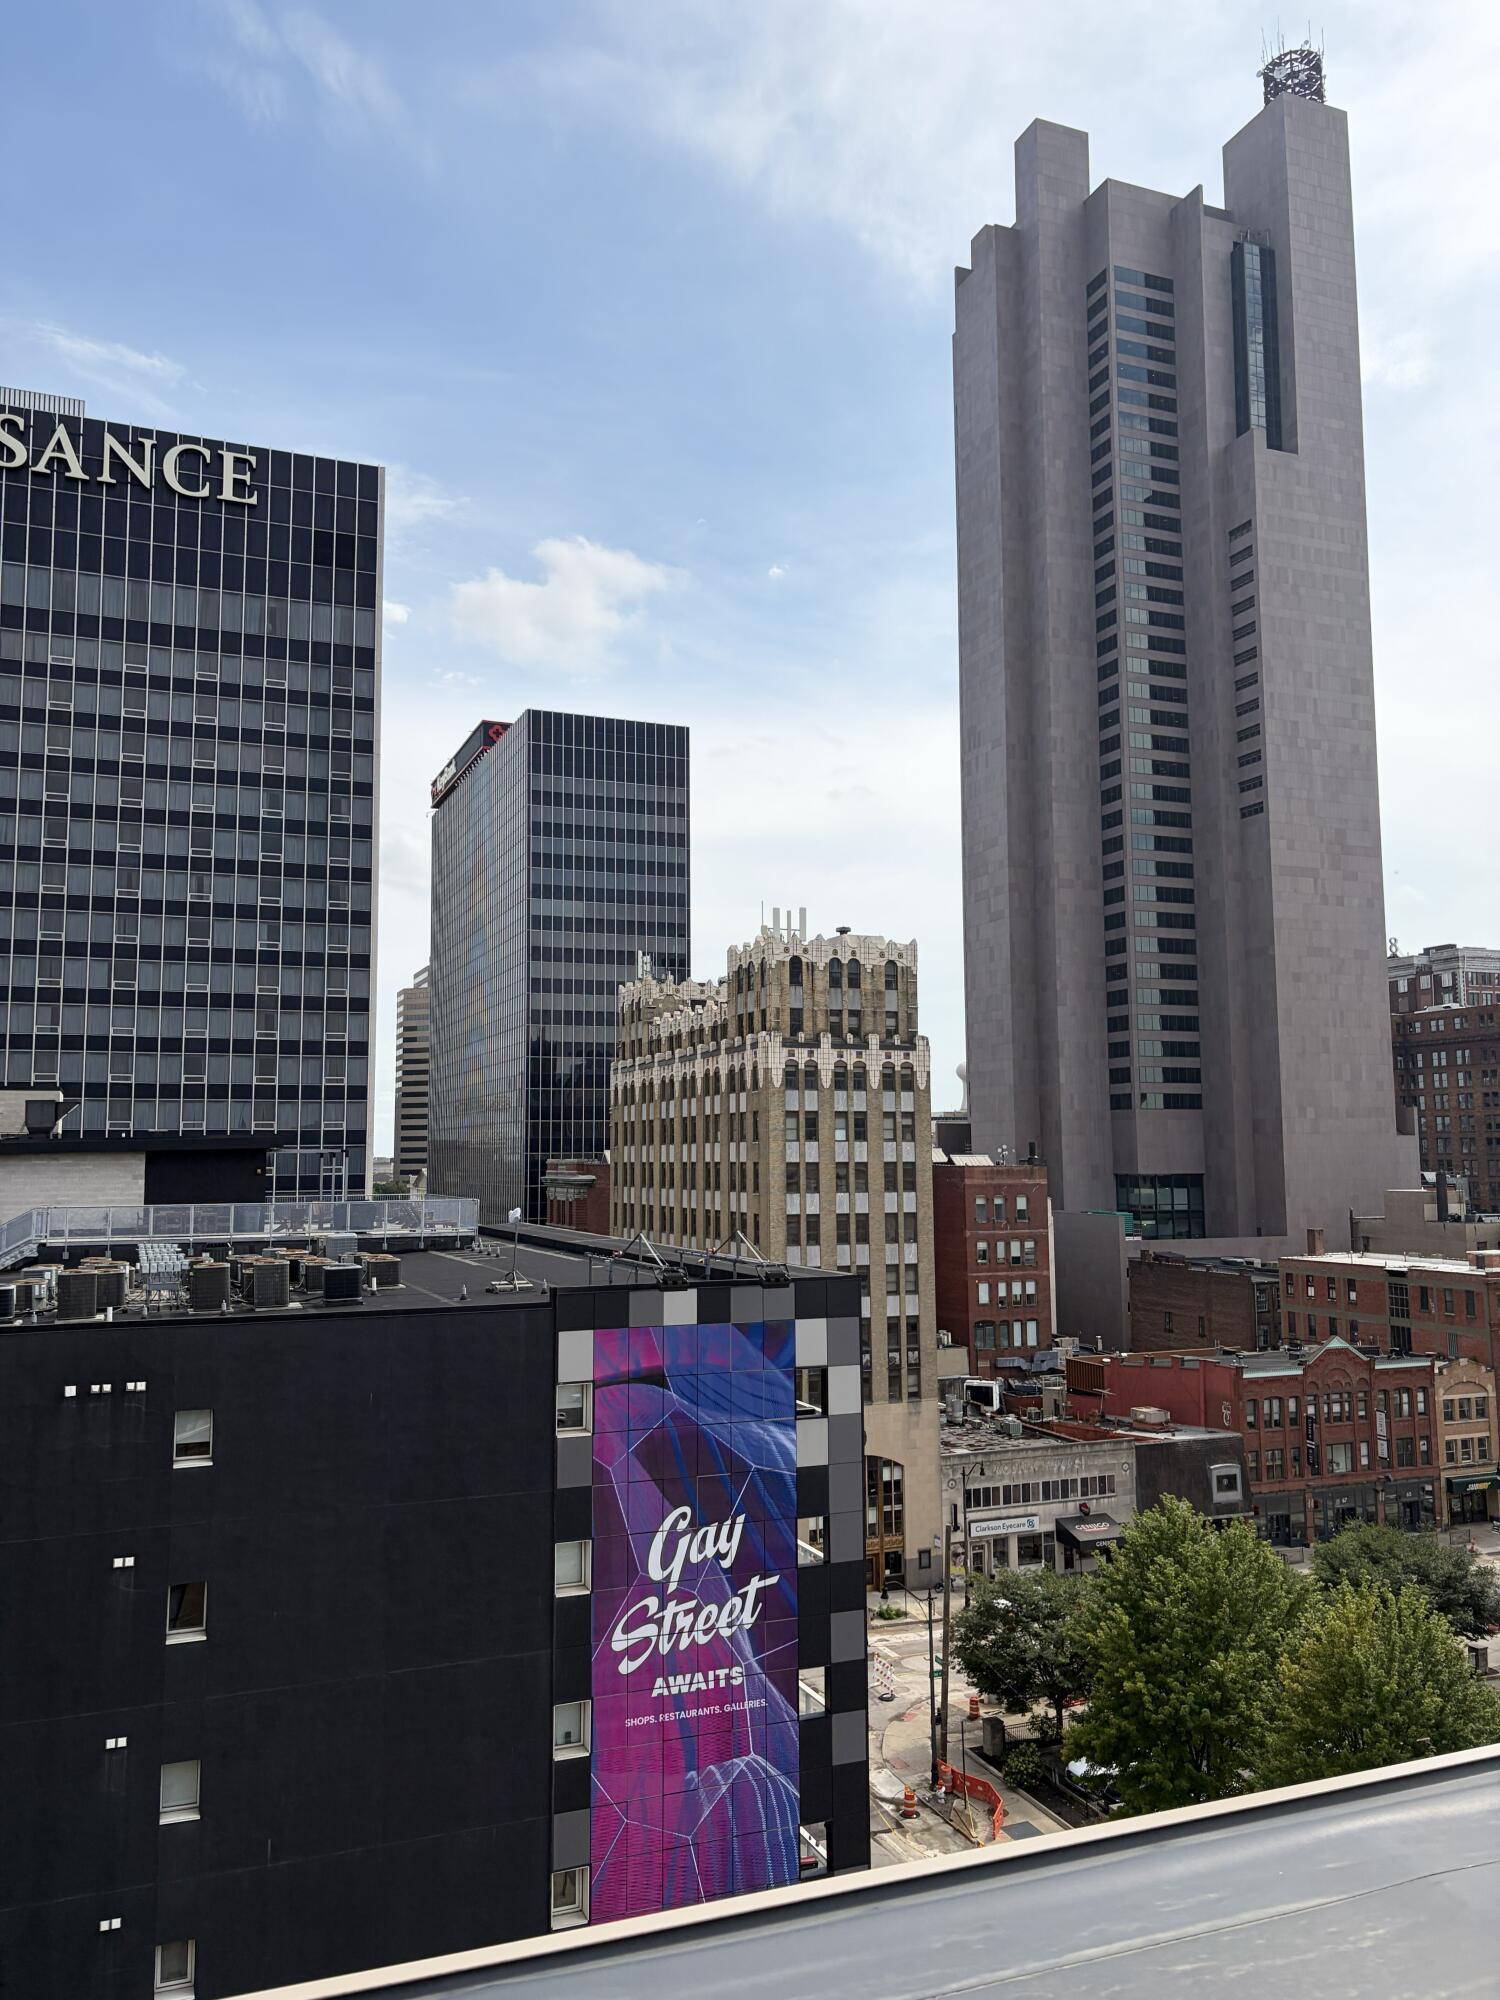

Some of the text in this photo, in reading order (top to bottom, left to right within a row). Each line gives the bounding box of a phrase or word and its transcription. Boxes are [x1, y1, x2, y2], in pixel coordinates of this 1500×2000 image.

[0, 412, 258, 506] SANCE
[648, 1505, 746, 1594] Gay
[975, 1521, 1026, 1533] Clarkson Eyecare
[611, 1574, 780, 1675] Street
[651, 1666, 744, 1698] AWAITS
[625, 1698, 769, 1728] SHOPS. RESTAURANTS. GALLERIES.
